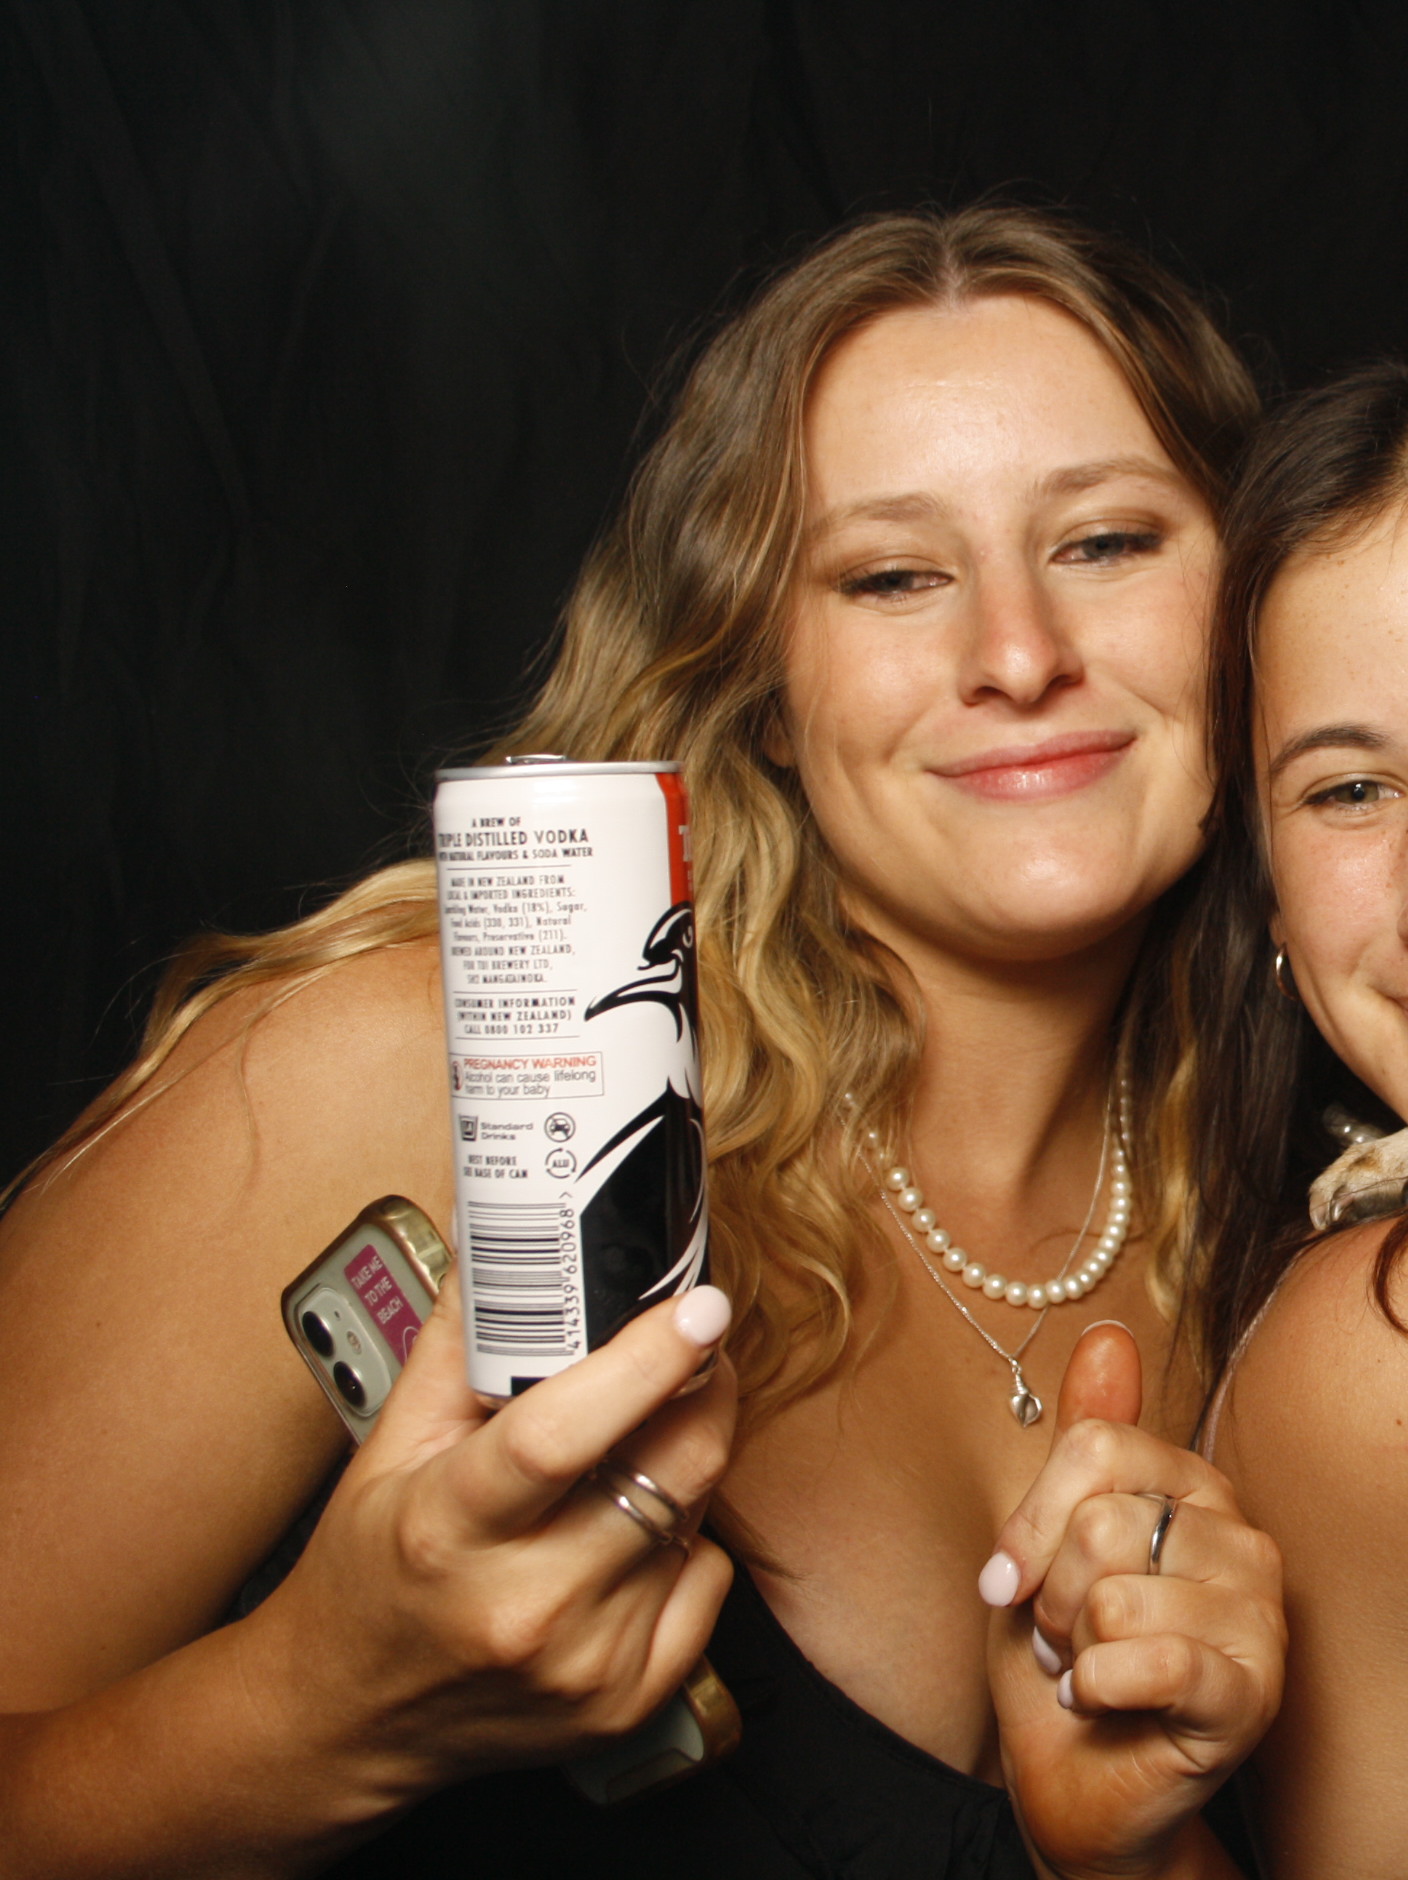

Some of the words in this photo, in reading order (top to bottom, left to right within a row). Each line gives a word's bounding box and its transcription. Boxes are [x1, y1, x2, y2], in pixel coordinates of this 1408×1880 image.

[472, 819, 476, 827] A
[480, 818, 505, 827] BREW
[509, 817, 521, 826] OF
[466, 831, 528, 847] DISTILLED
[534, 829, 589, 844] VODKA
[477, 850, 519, 860] FLAVOURS
[522, 850, 528, 859] &
[532, 849, 557, 859] SODA
[562, 847, 594, 857] WATER
[477, 876, 493, 886] NEW
[496, 875, 535, 886] ZEALAND
[539, 875, 564, 885] FROM
[471, 890, 508, 900] IMPORTED
[512, 887, 576, 899] INGREDIENTS:
[493, 903, 518, 913] Vodka
[556, 902, 588, 913] Sugar,
[536, 915, 572, 926] Natural
[483, 932, 534, 941] Preservative
[474, 946, 504, 956] AROUND
[508, 945, 526, 956] NEW
[531, 944, 575, 956] ZEALAND,
[492, 959, 529, 970] BREWERY
[455, 998, 494, 1008] CONSUMER
[498, 996, 576, 1008] INFORMATION
[491, 1011, 512, 1021] NEW
[517, 1010, 572, 1021] ZEALAND)
[464, 1025, 481, 1034] CALL
[485, 1024, 508, 1034] 0800
[513, 1024, 533, 1034] 102
[538, 1023, 559, 1034] 337
[464, 1058, 528, 1070] PREGNANCY
[533, 1056, 597, 1067] WARNING
[465, 1071, 492, 1083] Alcohol
[495, 1073, 513, 1083] can
[517, 1072, 550, 1083] cause
[554, 1070, 596, 1082] lifelong
[486, 1084, 495, 1094] to
[498, 1085, 520, 1098] your
[523, 1083, 551, 1097] baby
[480, 1123, 533, 1131] Standard
[481, 1132, 516, 1140] Drinks
[485, 1155, 517, 1166] BEFORE
[552, 1158, 570, 1168] ALU
[494, 1168, 505, 1178] OF
[509, 1169, 528, 1179] CAN
[351, 1265, 372, 1290] TAKE
[369, 1255, 384, 1276] ME
[364, 1287, 379, 1305] TO
[375, 1278, 393, 1296] THE
[377, 1298, 404, 1325] BEACH
